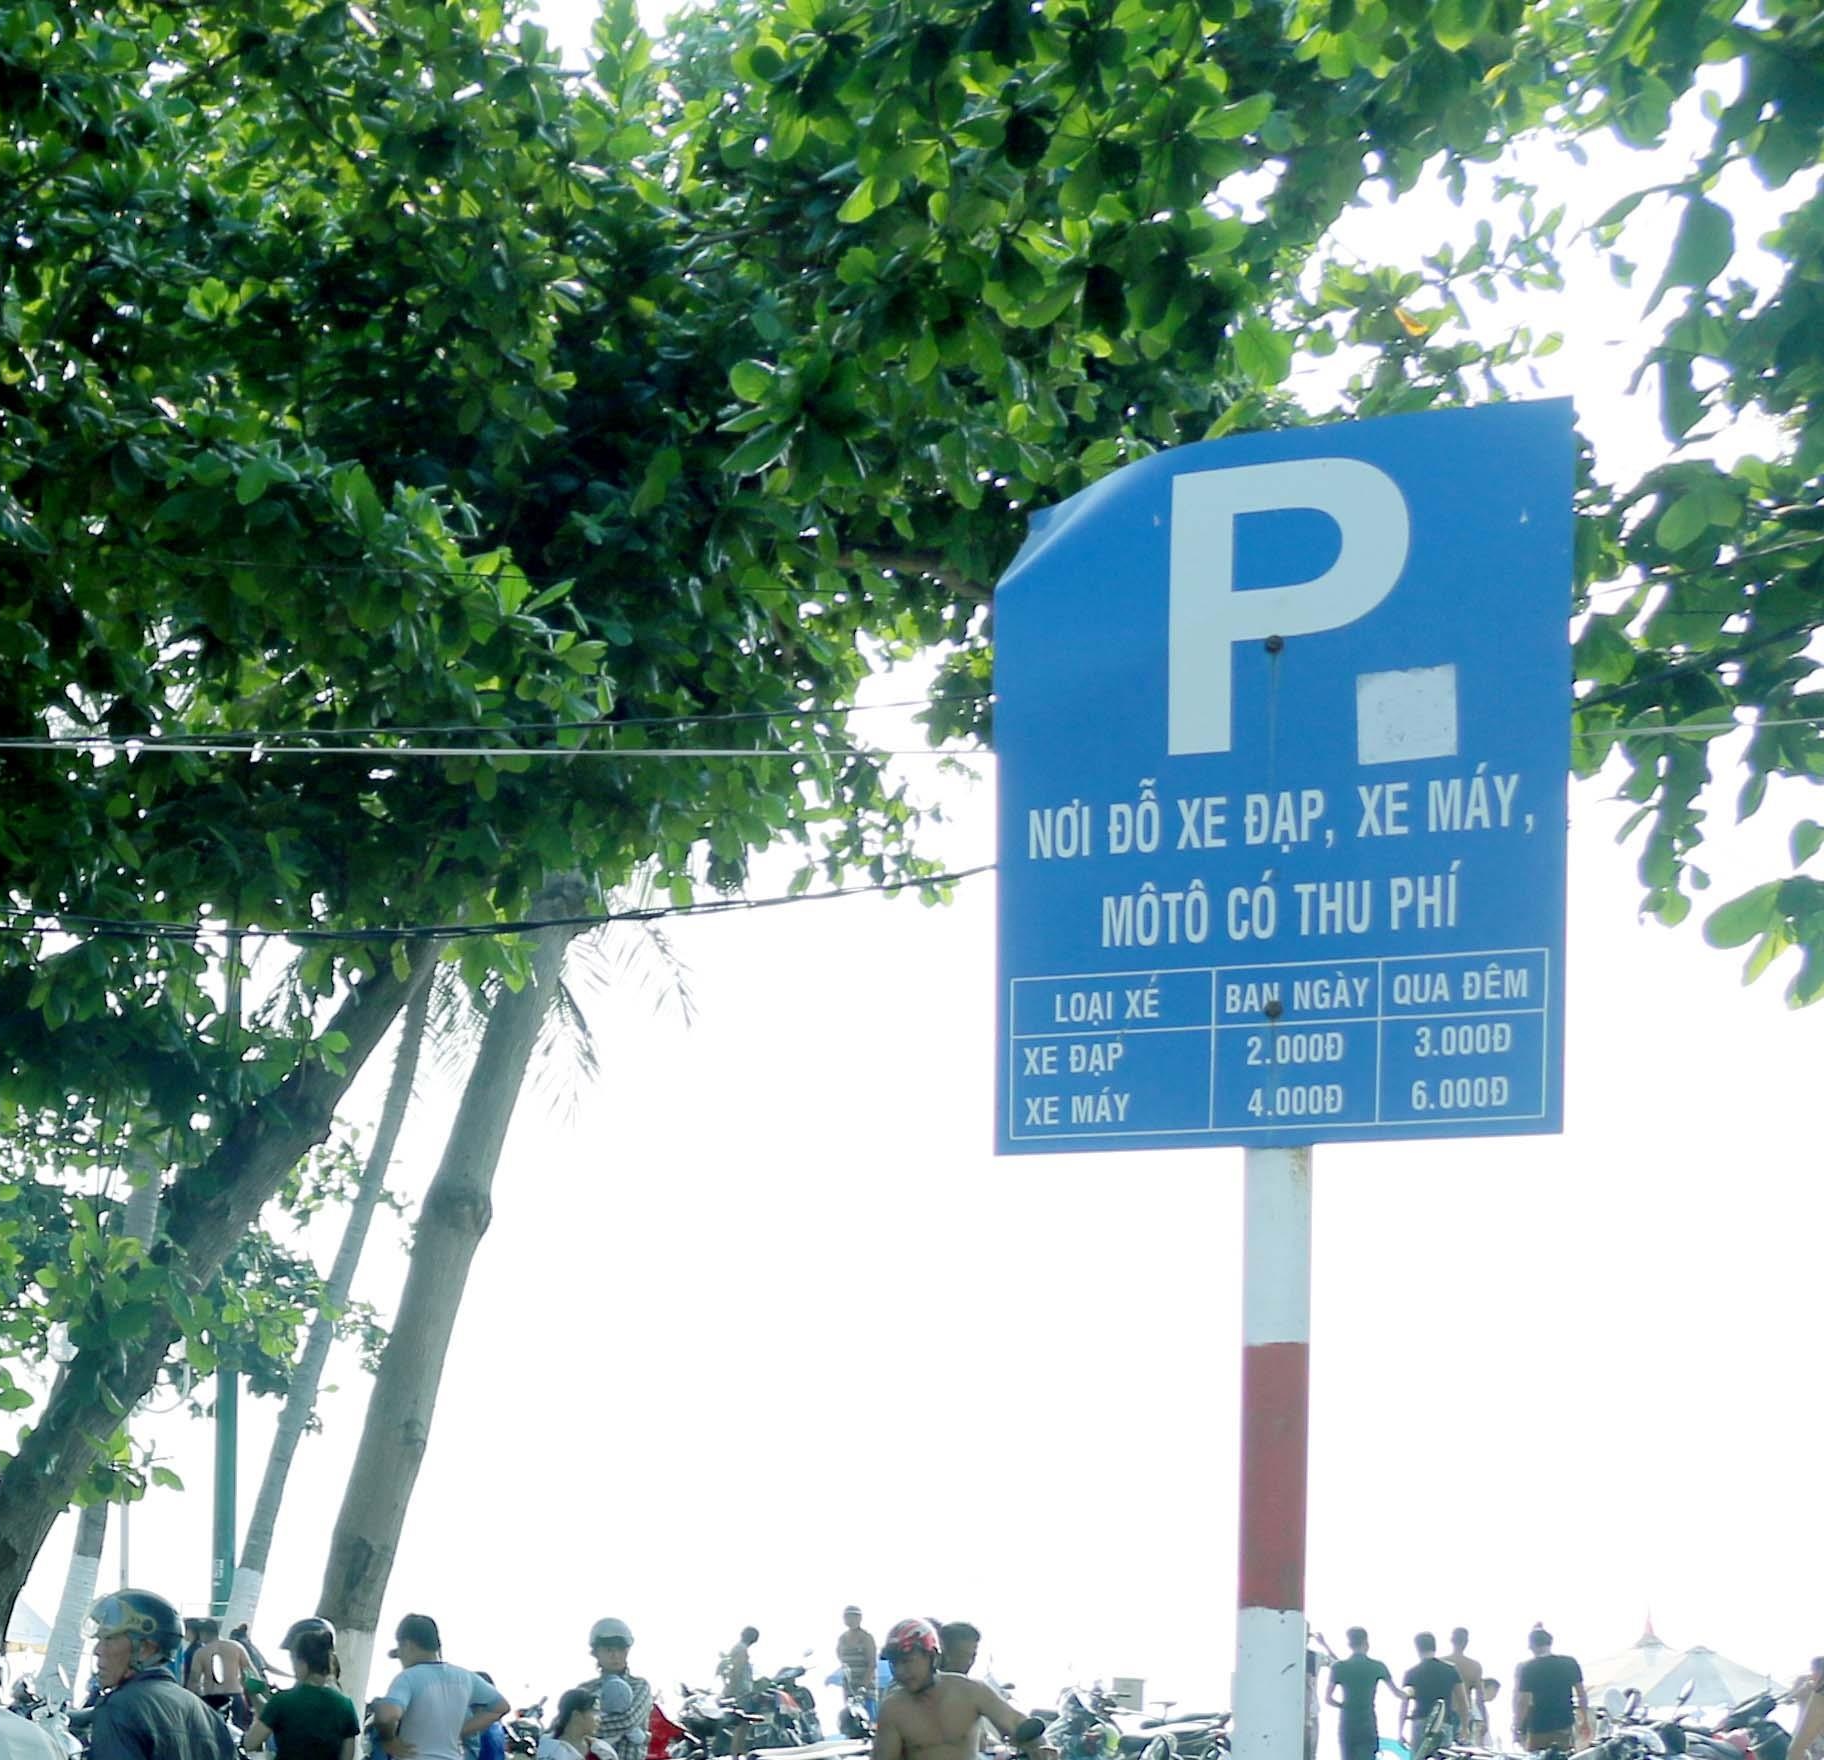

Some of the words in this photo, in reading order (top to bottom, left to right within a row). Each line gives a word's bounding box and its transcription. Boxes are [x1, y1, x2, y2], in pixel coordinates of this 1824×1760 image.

[1167, 457, 1411, 757] P
[1029, 798, 1091, 860] NƠI
[1107, 778, 1160, 854] ĐỖ
[1177, 796, 1227, 850] XE
[1243, 789, 1334, 853] ĐẠP,
[1357, 782, 1409, 838] XE
[1428, 762, 1534, 833] MÁY,
[1102, 878, 1209, 948] MÔTÔ
[1227, 869, 1276, 941] CÓ
[1293, 879, 1371, 936] THU
[1390, 859, 1461, 930] PHÍ
[1225, 982, 1280, 1014] BAN
[1293, 971, 1370, 1011] NGÀY
[1393, 972, 1451, 1006] QUA
[1462, 964, 1529, 1001] ĐÊM
[1055, 991, 1113, 1026] LOẠI
[1246, 1031, 1344, 1066] 2.000Đ
[1414, 1022, 1513, 1058] 3.000Đ
[1023, 1045, 1059, 1076] XE
[1068, 1042, 1124, 1076] ĐẠP
[1024, 1095, 1060, 1126] XE
[1071, 1093, 1130, 1124] MÁY
[1247, 1084, 1344, 1117] 4.000Đ
[1411, 1075, 1510, 1111] 6.000Đ
